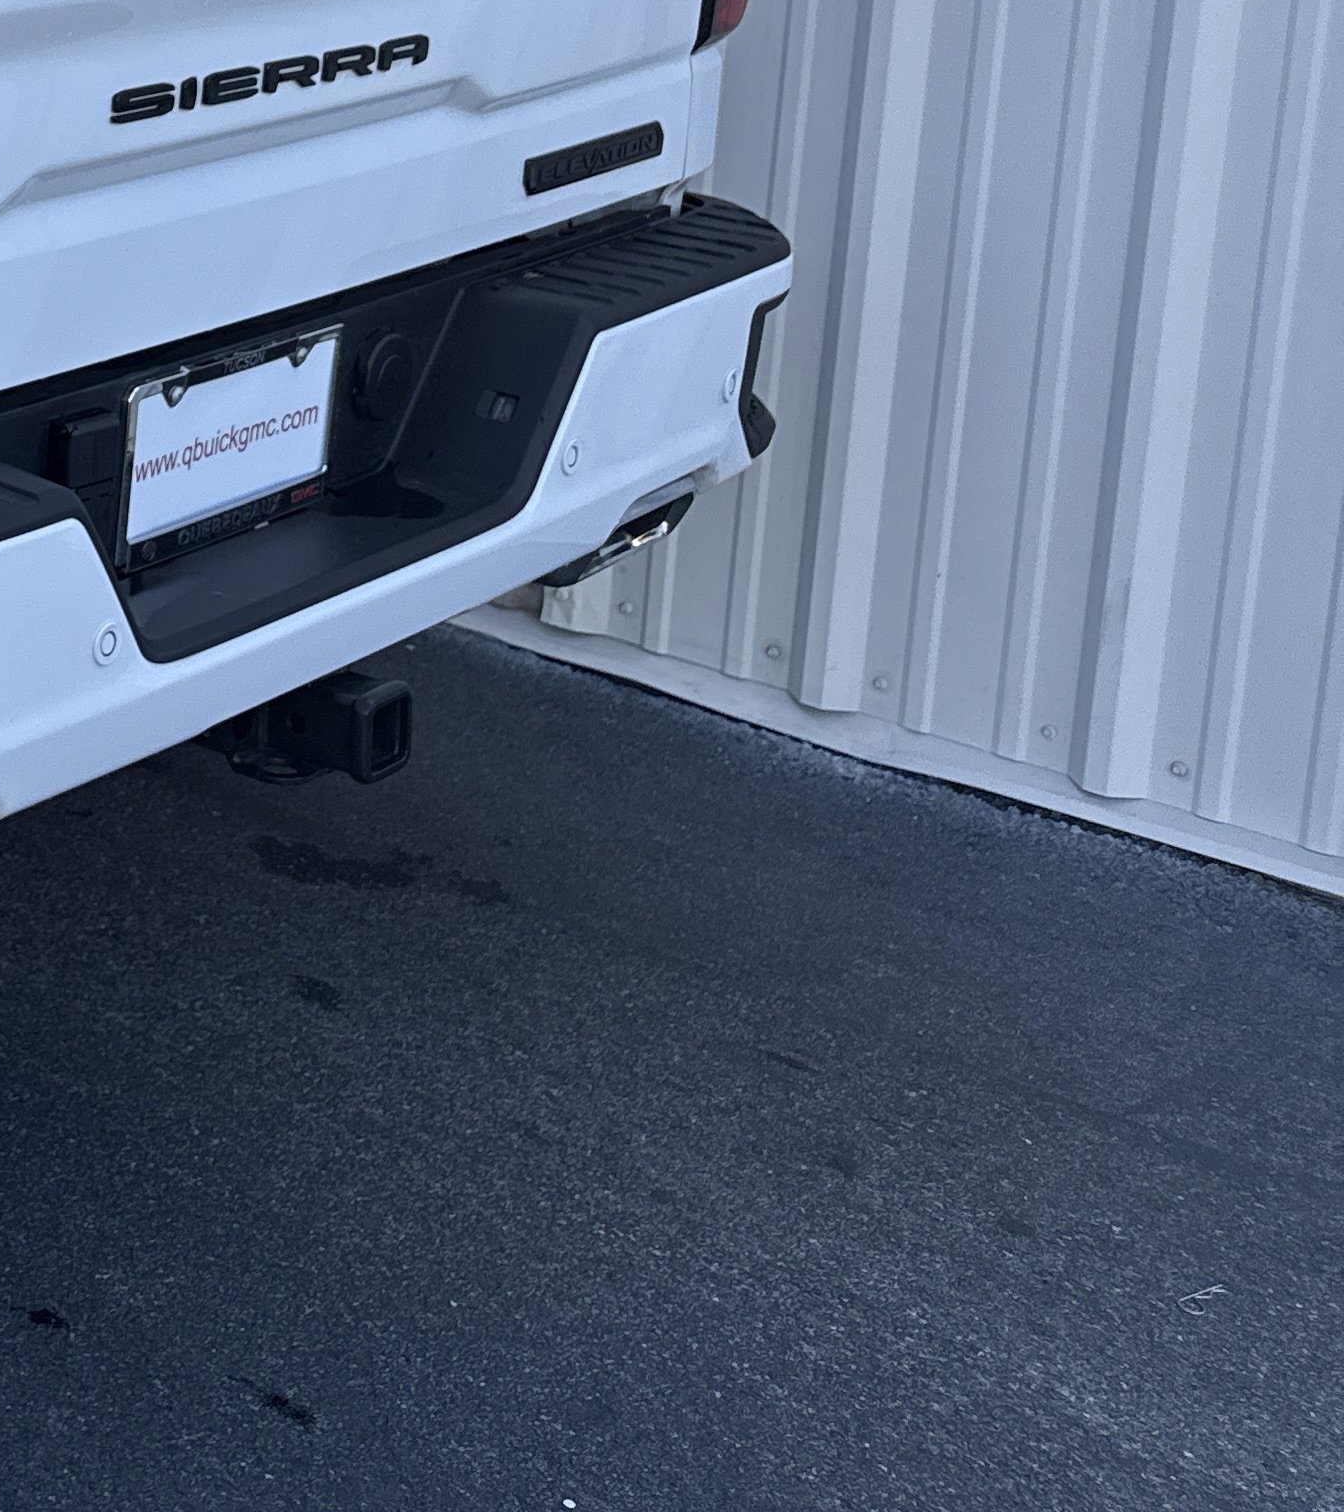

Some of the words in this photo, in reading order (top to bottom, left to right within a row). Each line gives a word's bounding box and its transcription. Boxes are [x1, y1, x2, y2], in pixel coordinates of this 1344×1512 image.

[110, 33, 429, 124] SIERRA
[535, 132, 658, 185] ELEVATION
[222, 350, 267, 375] TUCSON
[134, 404, 319, 483] www.qbuickgmc.com
